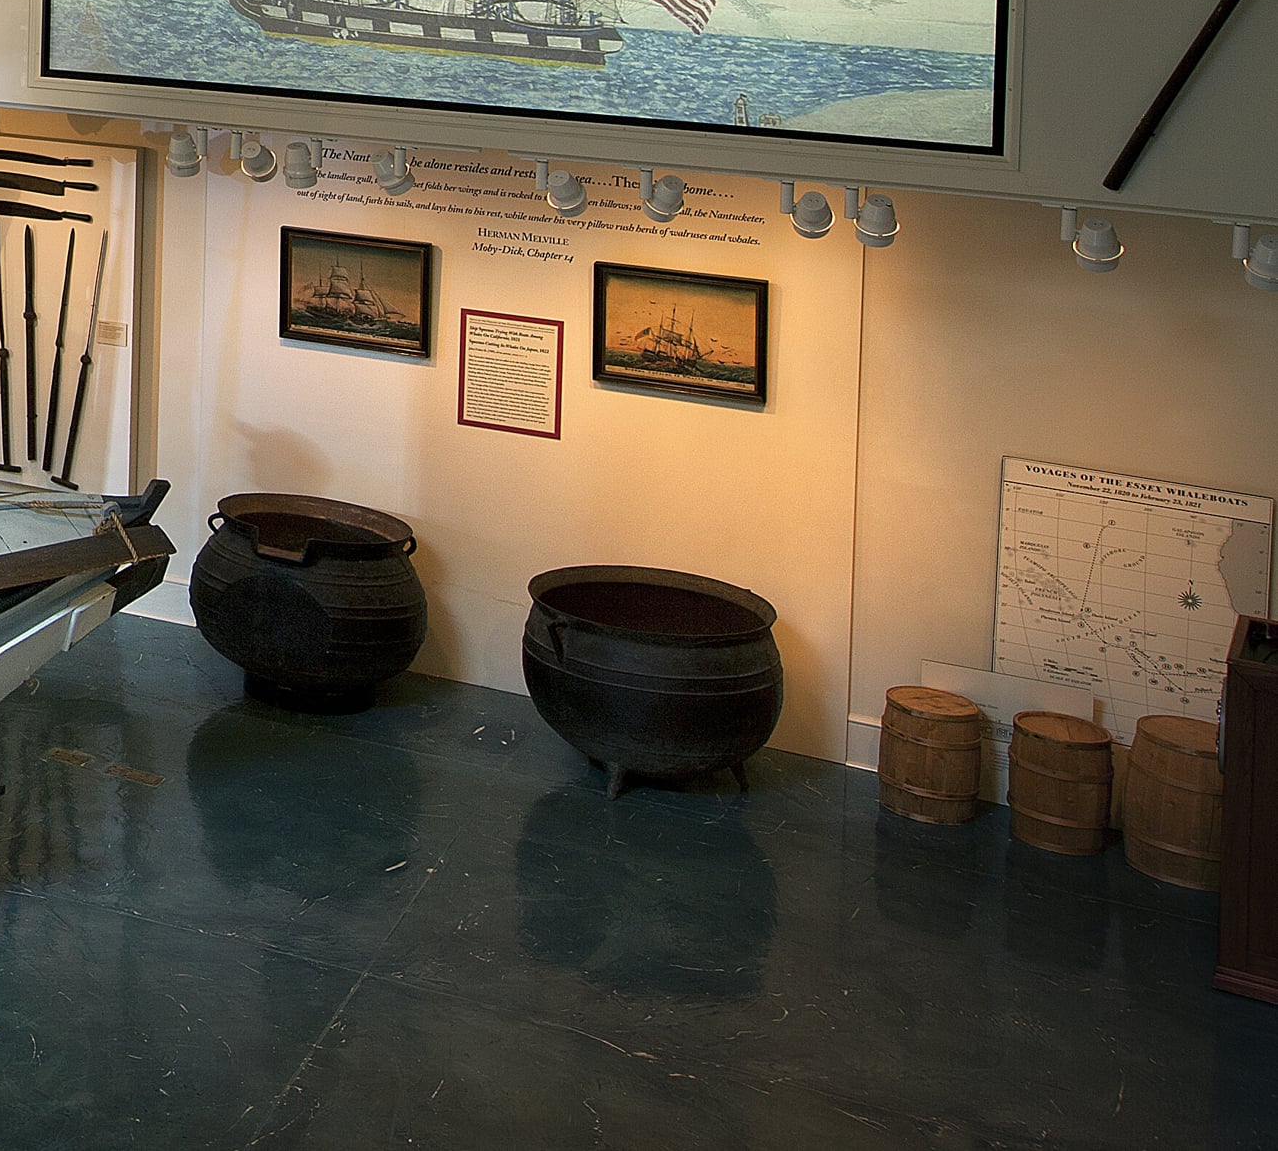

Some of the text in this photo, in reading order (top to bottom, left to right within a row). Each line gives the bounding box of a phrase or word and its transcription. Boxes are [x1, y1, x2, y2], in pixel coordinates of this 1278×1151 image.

[322, 148, 342, 159] The
[410, 157, 422, 168] he
[424, 159, 452, 170] alone
[454, 162, 488, 174] resides
[490, 166, 512, 176] and
[514, 169, 536, 180] rests
[327, 172, 356, 181] landless
[356, 176, 374, 185] gull,
[424, 182, 442, 192] folds
[458, 186, 482, 196] wings
[483, 188, 498, 196] and
[508, 191, 533, 200] rocked
[599, 200, 632, 211] billows;
[694, 209, 708, 217] the
[709, 210, 765, 224] Nantucketer,
[310, 190, 320, 200] of
[319, 192, 336, 201] sight
[337, 193, 346, 202] of
[346, 194, 365, 203] land,
[365, 196, 383, 205] furls
[396, 199, 414, 210] sails,
[415, 202, 431, 210] and
[431, 203, 446, 214] lays
[448, 204, 463, 213] him
[474, 208, 485, 216] his
[486, 210, 503, 219] rest,
[504, 212, 527, 220] while
[528, 215, 553, 223] under
[554, 216, 565, 225] his
[566, 219, 586, 229] very
[587, 220, 614, 230] pillow
[615, 224, 634, 232] rush
[635, 224, 658, 234] herds
[660, 226, 669, 238] of
[669, 230, 707, 239] walruses
[708, 233, 727, 242] and
[727, 235, 760, 246] whales.
[472, 242, 574, 263] Moby-Dick, Chapter 14
[478, 227, 569, 246] HERMAN MELVILLE
[1026, 465, 1249, 507] VOYAGES OF THE ESSEX WHALEBOATS
[1066, 481, 1100, 492] November
[1140, 493, 1170, 504] February
